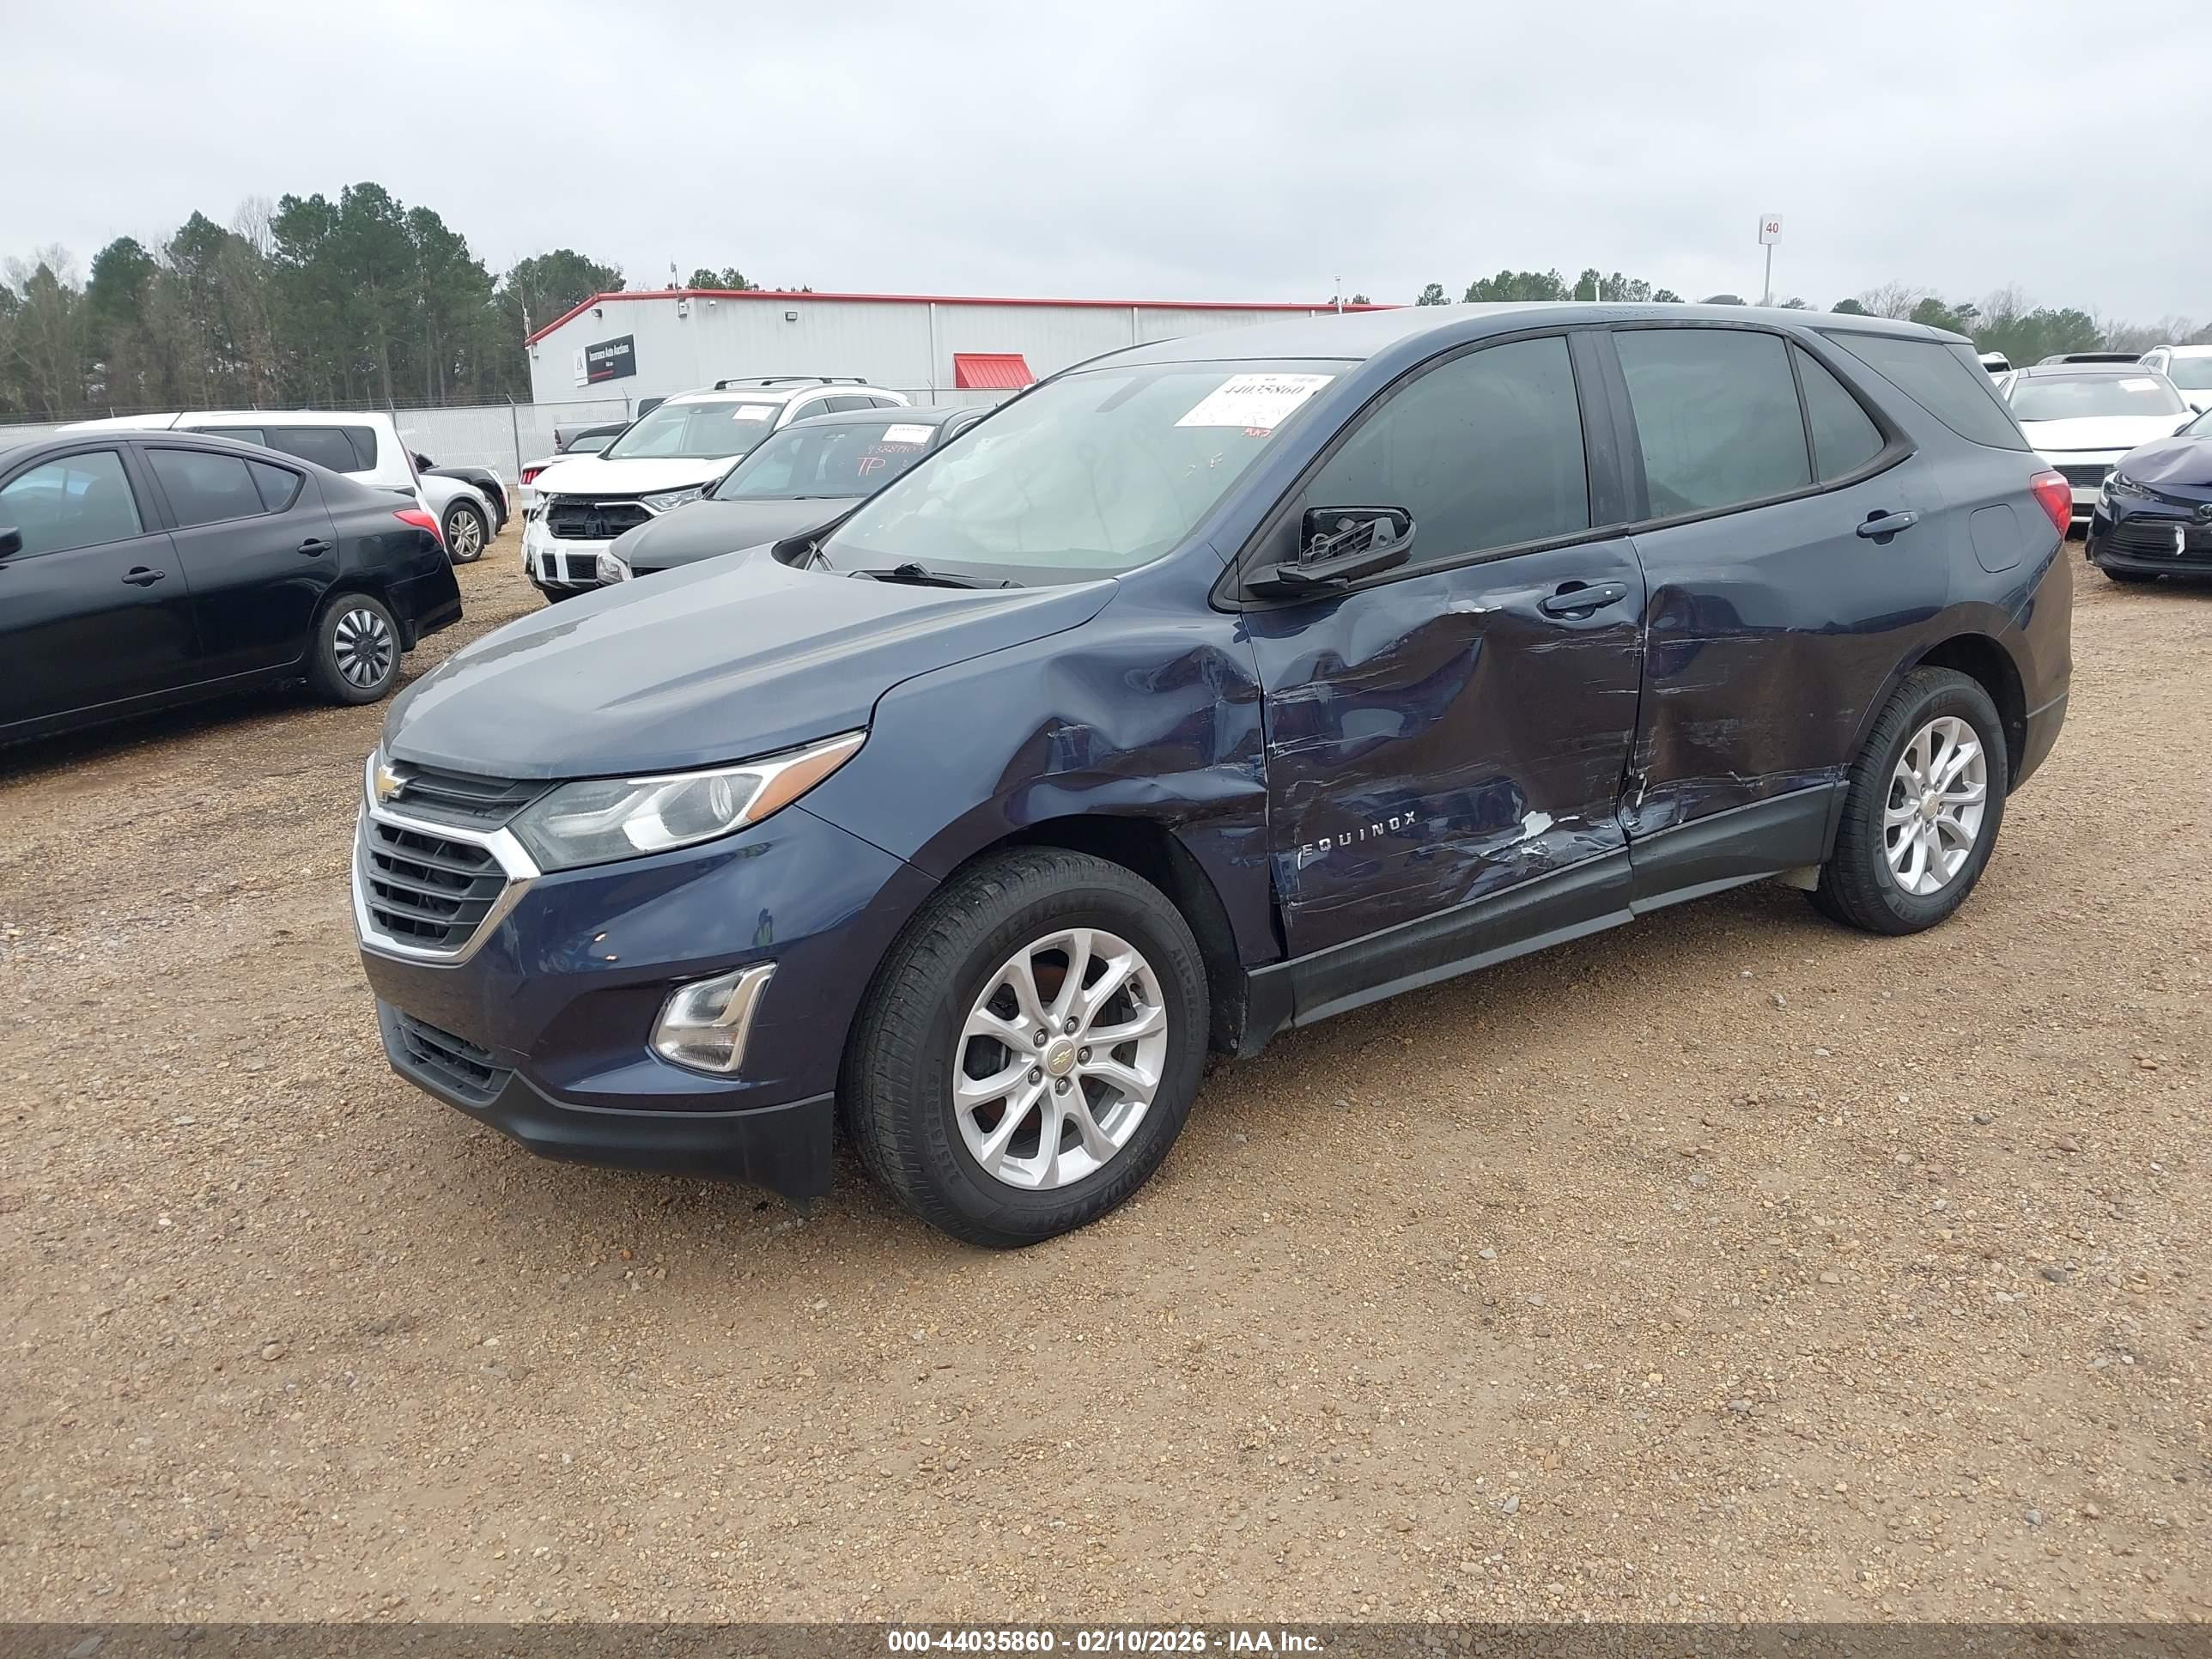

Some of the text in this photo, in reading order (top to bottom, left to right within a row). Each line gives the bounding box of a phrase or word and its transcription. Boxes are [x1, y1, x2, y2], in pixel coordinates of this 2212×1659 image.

[1765, 222, 1779, 234] 40
[1224, 385, 1306, 395] 44035860
[858, 458, 886, 477] TP
[1302, 811, 1416, 857] EQUINOX
